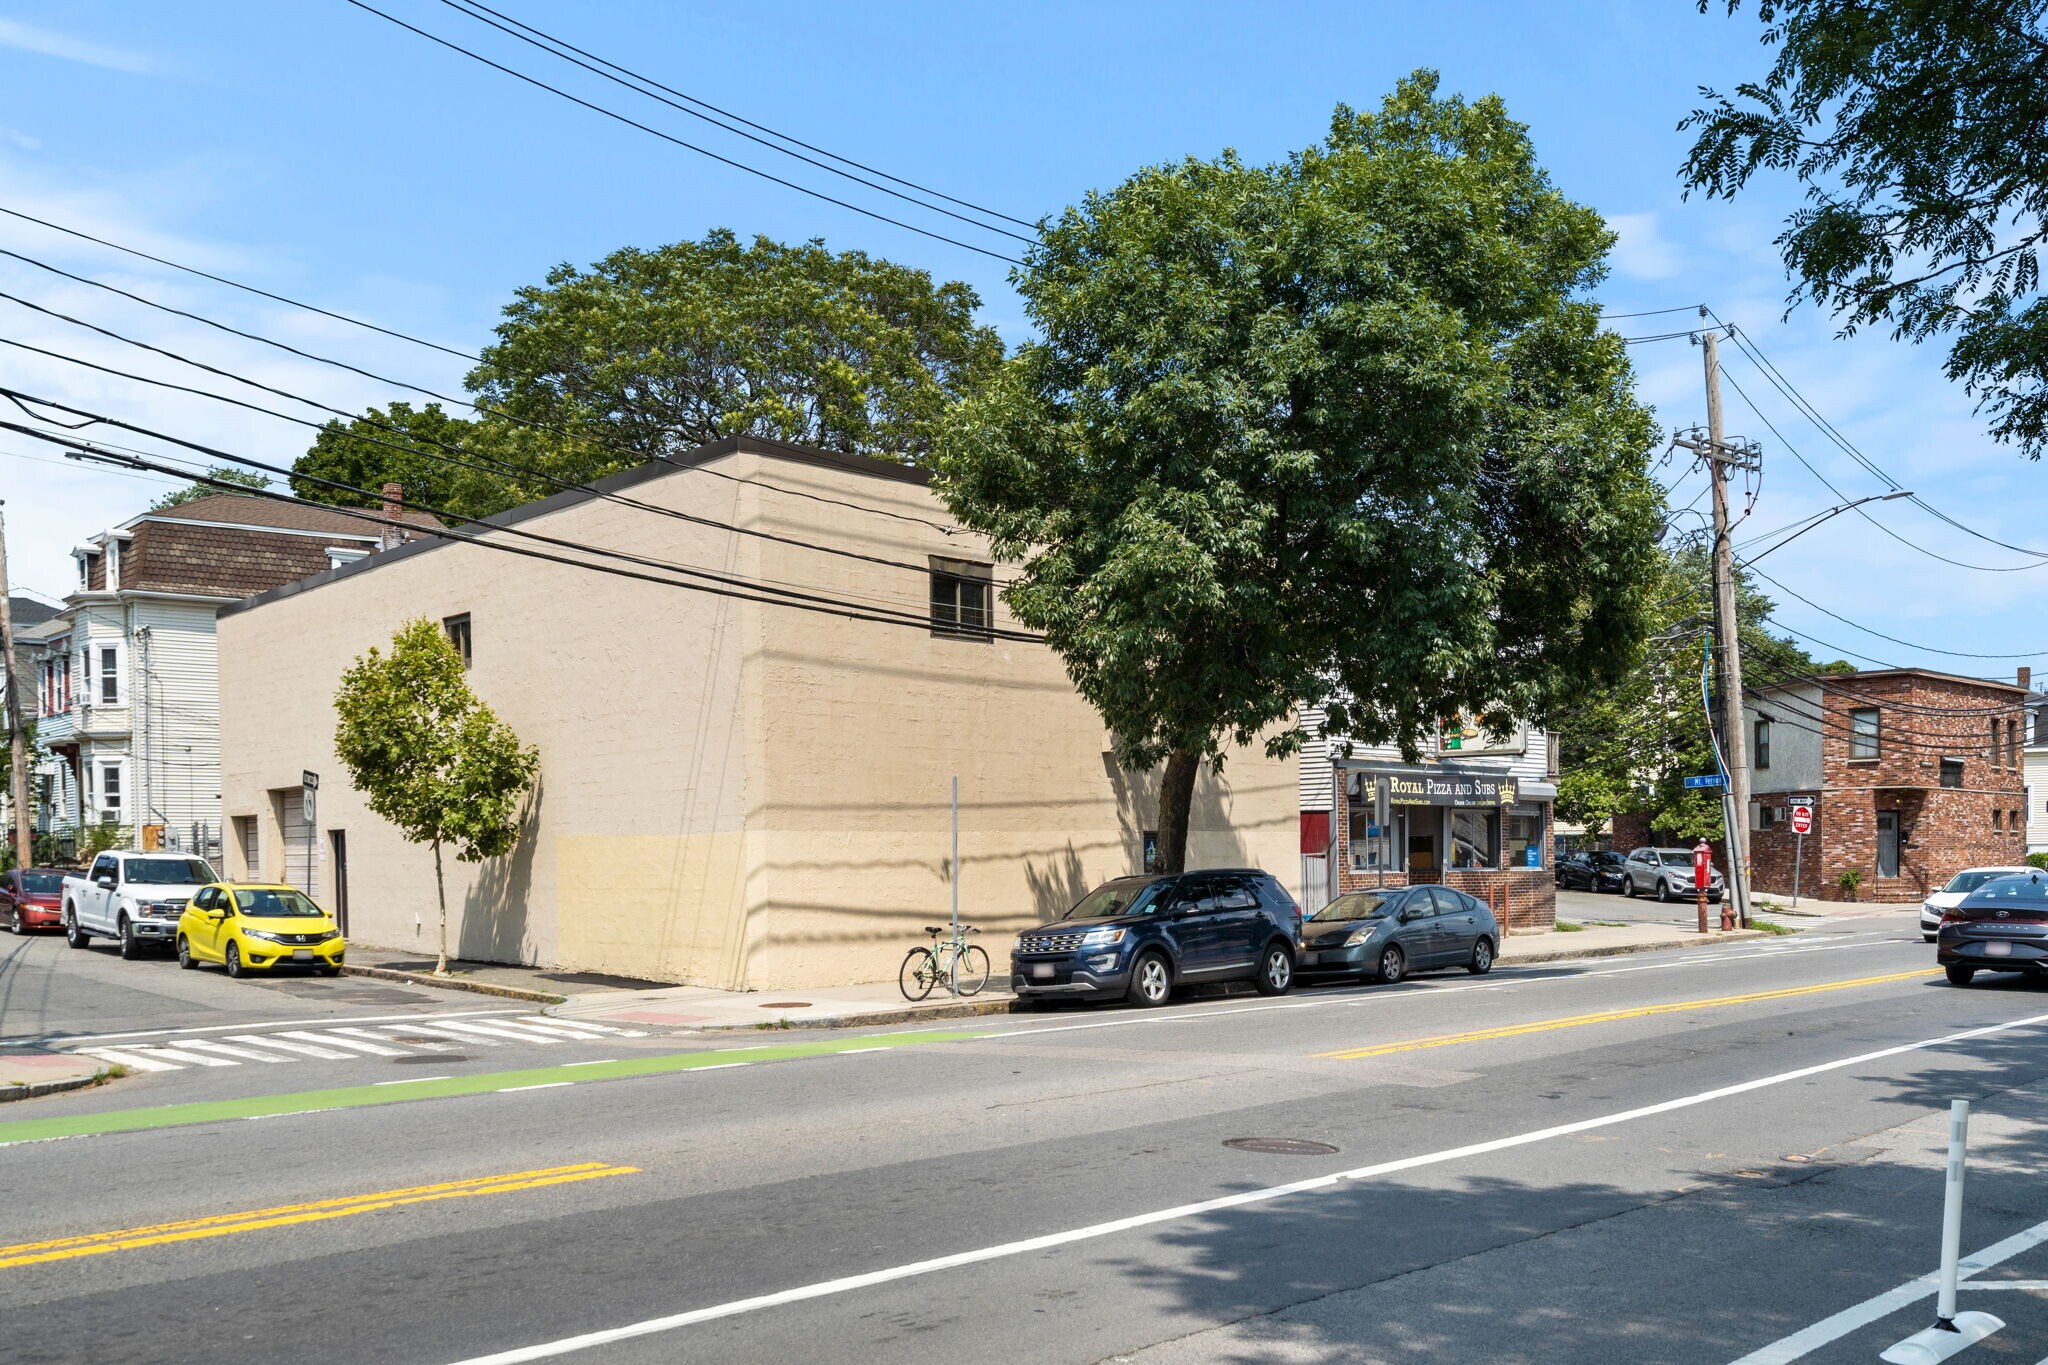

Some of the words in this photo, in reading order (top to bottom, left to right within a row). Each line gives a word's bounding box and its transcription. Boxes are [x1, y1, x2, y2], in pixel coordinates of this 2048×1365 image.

[1390, 777, 1424, 794] ROYAL
[1426, 779, 1452, 795] PIZZA
[1454, 783, 1472, 795] AND
[1475, 780, 1496, 795] SUBS
